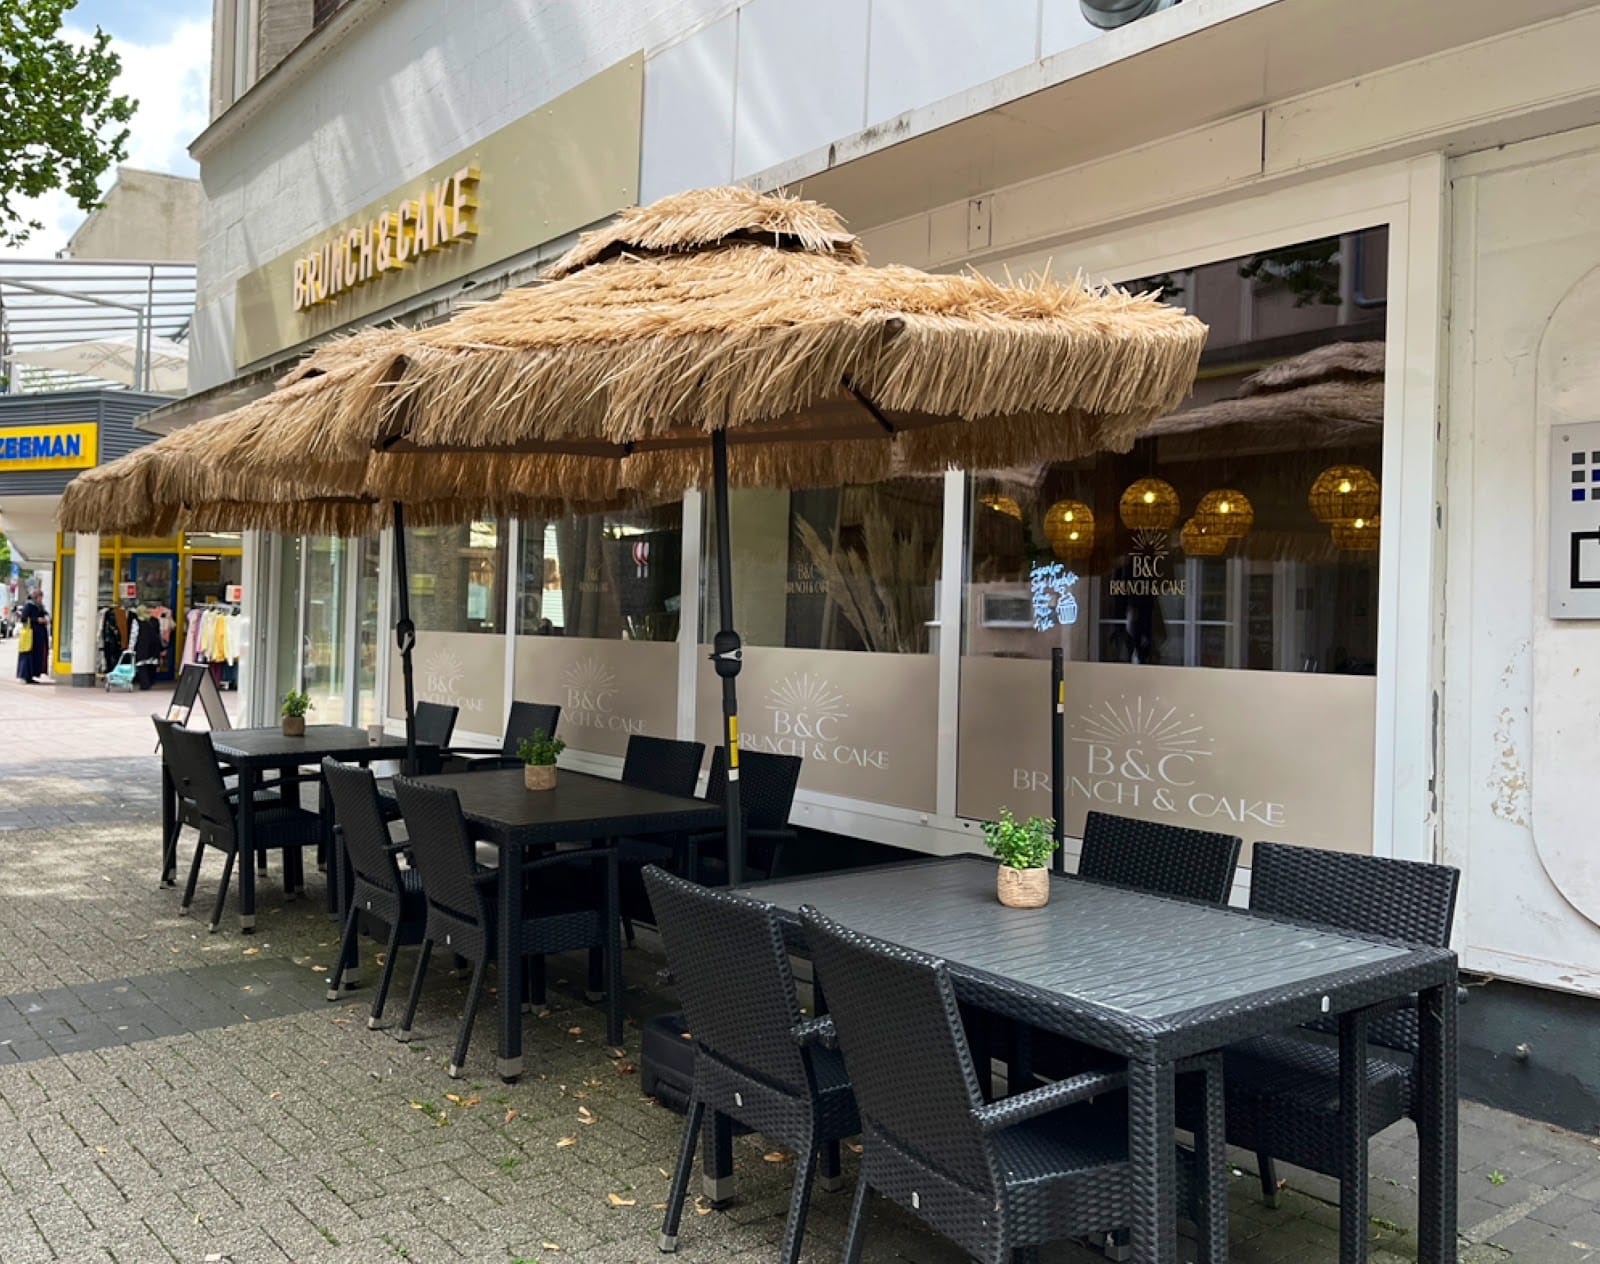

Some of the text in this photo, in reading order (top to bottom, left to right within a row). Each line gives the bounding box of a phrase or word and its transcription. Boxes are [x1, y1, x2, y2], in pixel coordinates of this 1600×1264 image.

[294, 165, 477, 312] BRUNCH&CAKE
[1132, 554, 1165, 578] B&C
[1110, 579, 1188, 596] BRUNCH & CAKE
[567, 687, 614, 713] B&C
[560, 709, 648, 734] NCH & CAKE
[774, 710, 840, 742] B&C
[738, 732, 890, 770] RUNCH & CAKE
[1087, 744, 1196, 787] B&C
[1152, 787, 1178, 813] &
[1187, 792, 1288, 828] CAKE
